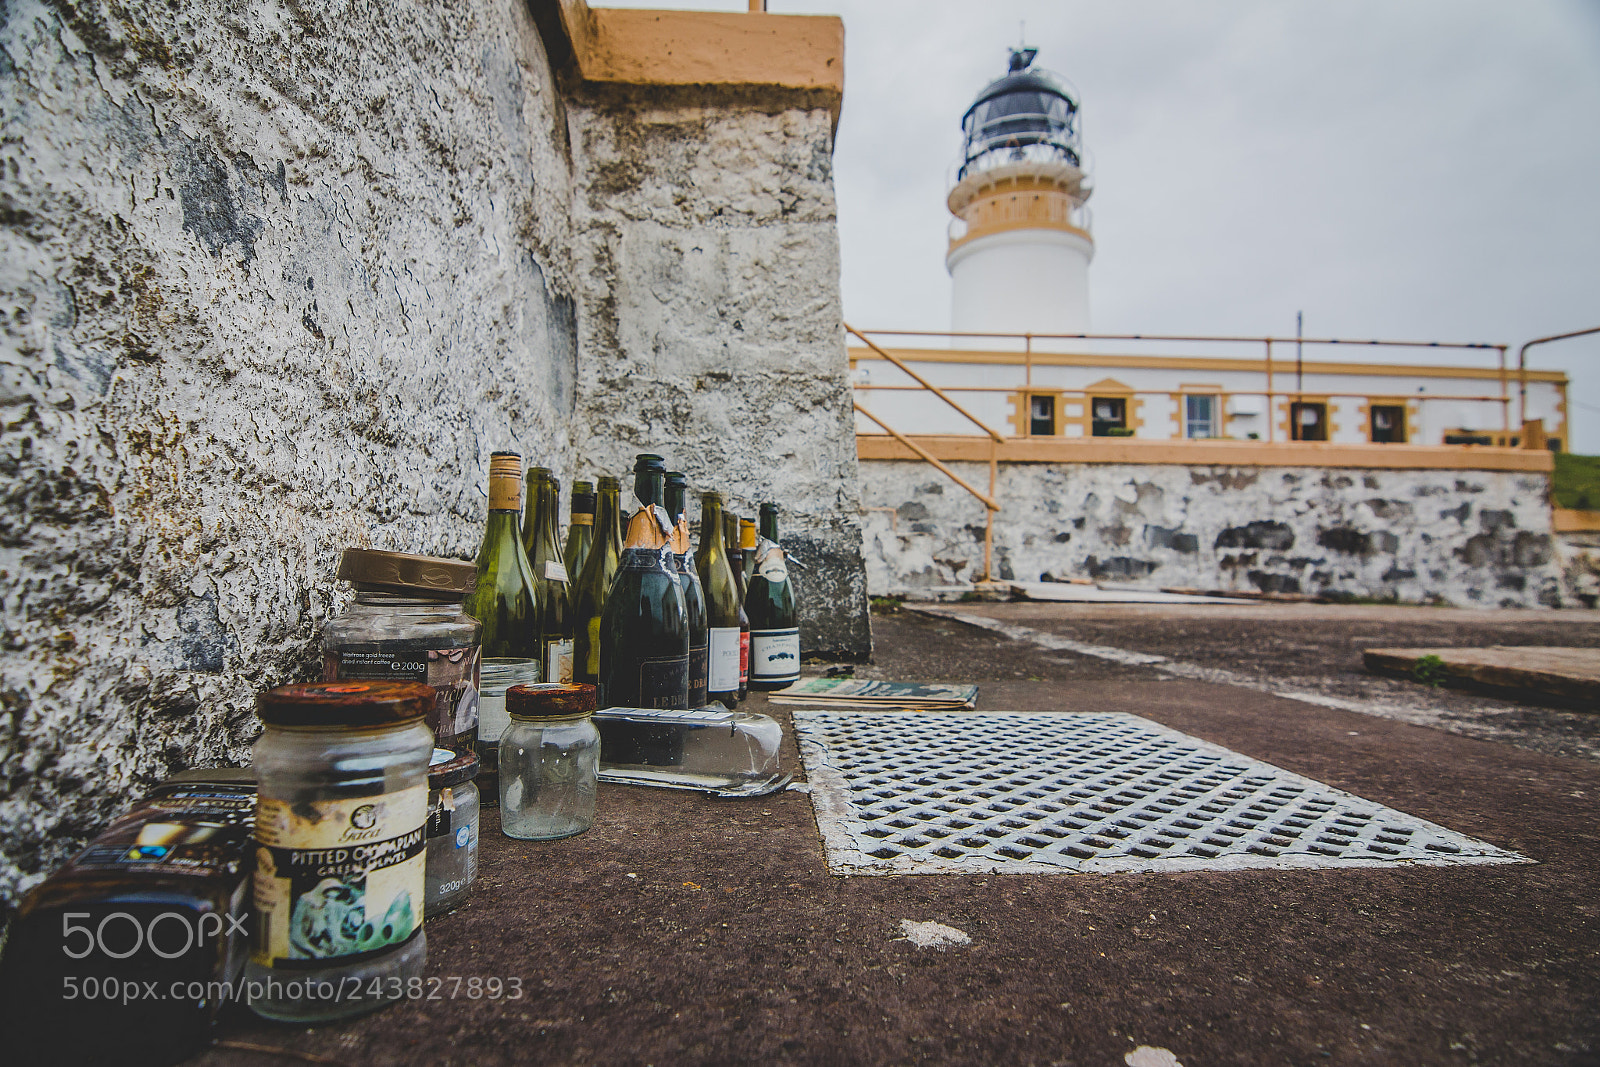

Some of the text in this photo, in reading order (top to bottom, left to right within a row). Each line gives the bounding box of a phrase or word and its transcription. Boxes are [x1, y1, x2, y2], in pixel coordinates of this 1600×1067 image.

[401, 661, 425, 673] 200g
[290, 848, 350, 866] PITTED
[316, 860, 363, 877] GREE
[439, 880, 460, 895] 320g
